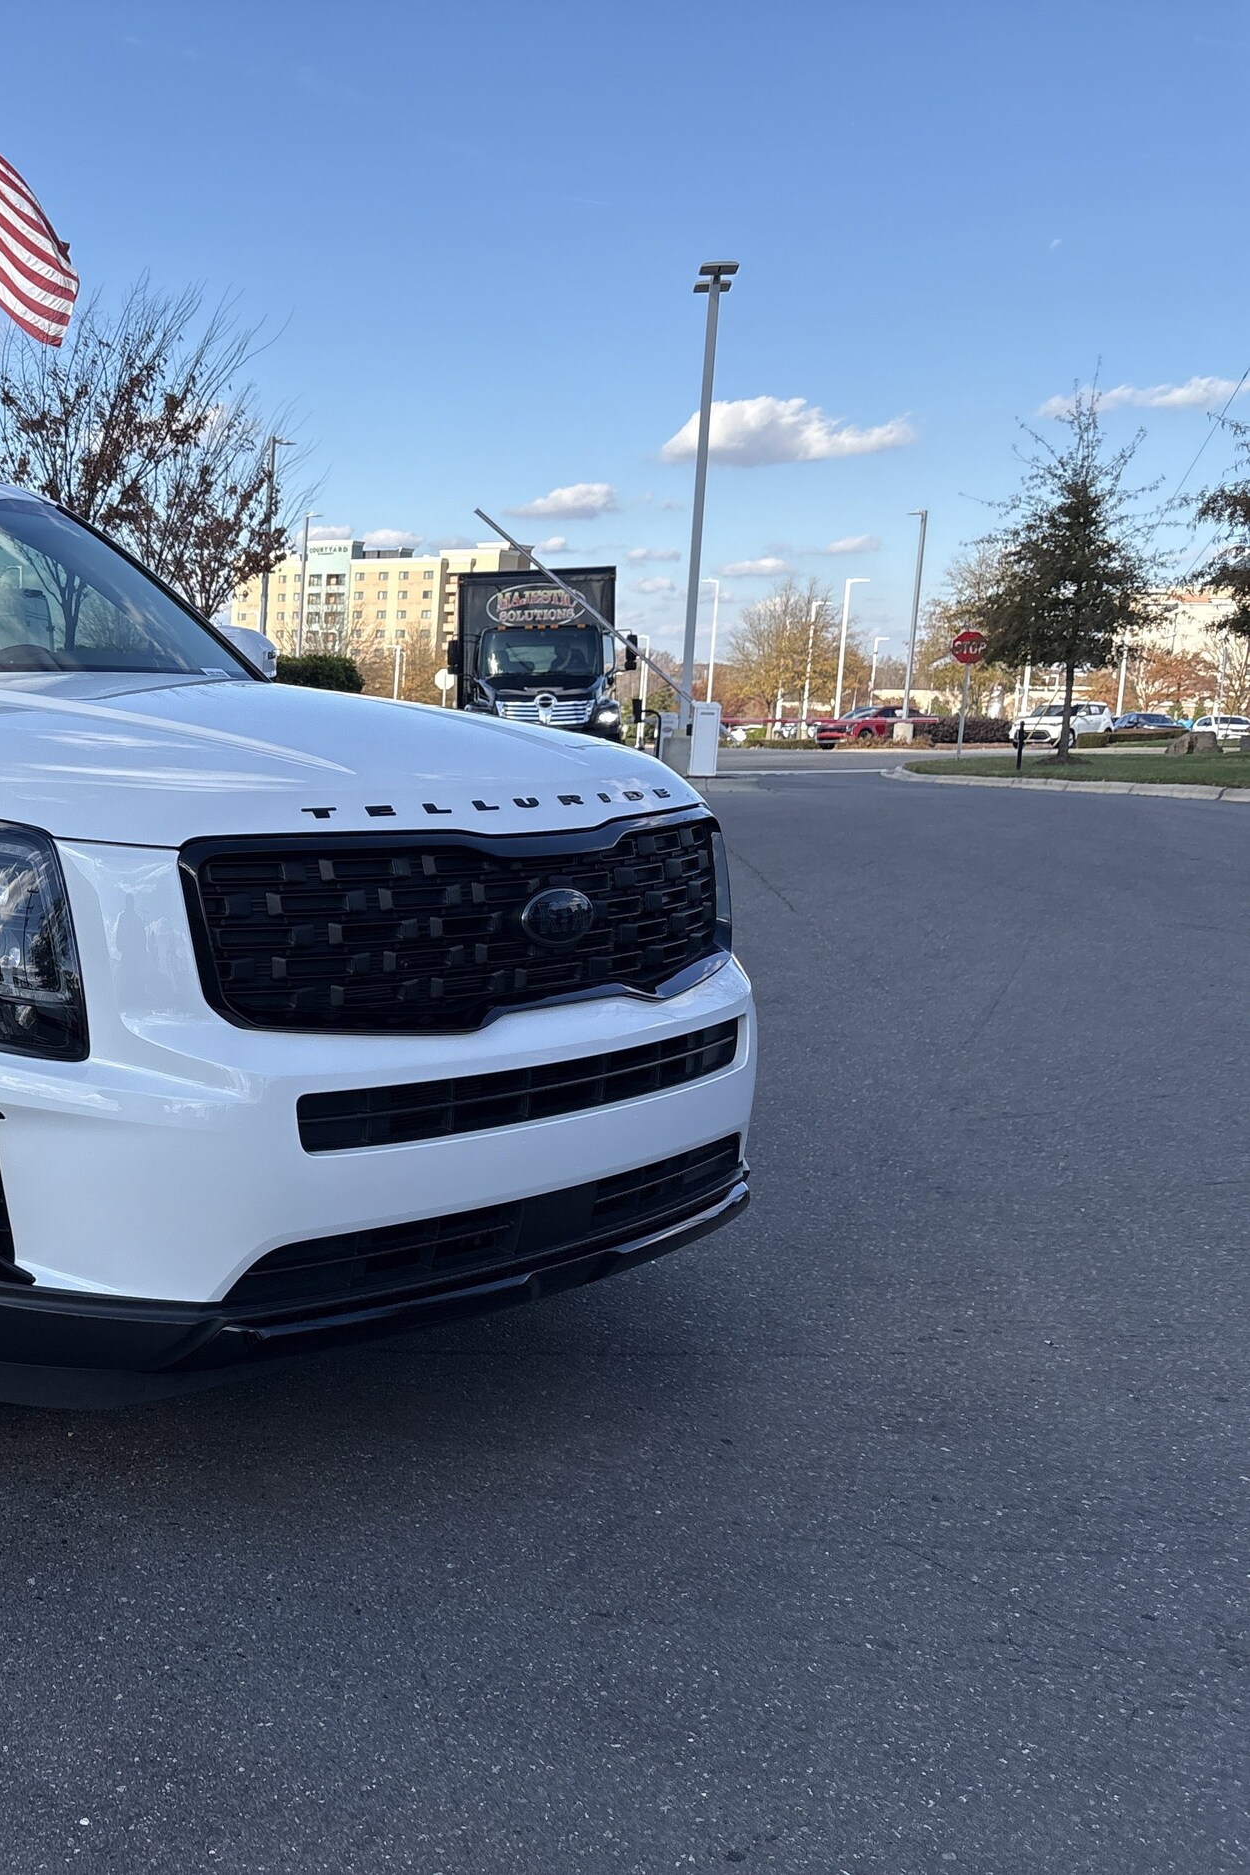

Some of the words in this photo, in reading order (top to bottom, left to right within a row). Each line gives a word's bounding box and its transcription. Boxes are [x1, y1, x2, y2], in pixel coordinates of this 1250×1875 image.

[496, 589, 578, 612] MAJESTIC
[498, 608, 575, 622] SOLUTIONS
[954, 641, 988, 655] STOP
[300, 787, 671, 820] TELLURIDE
